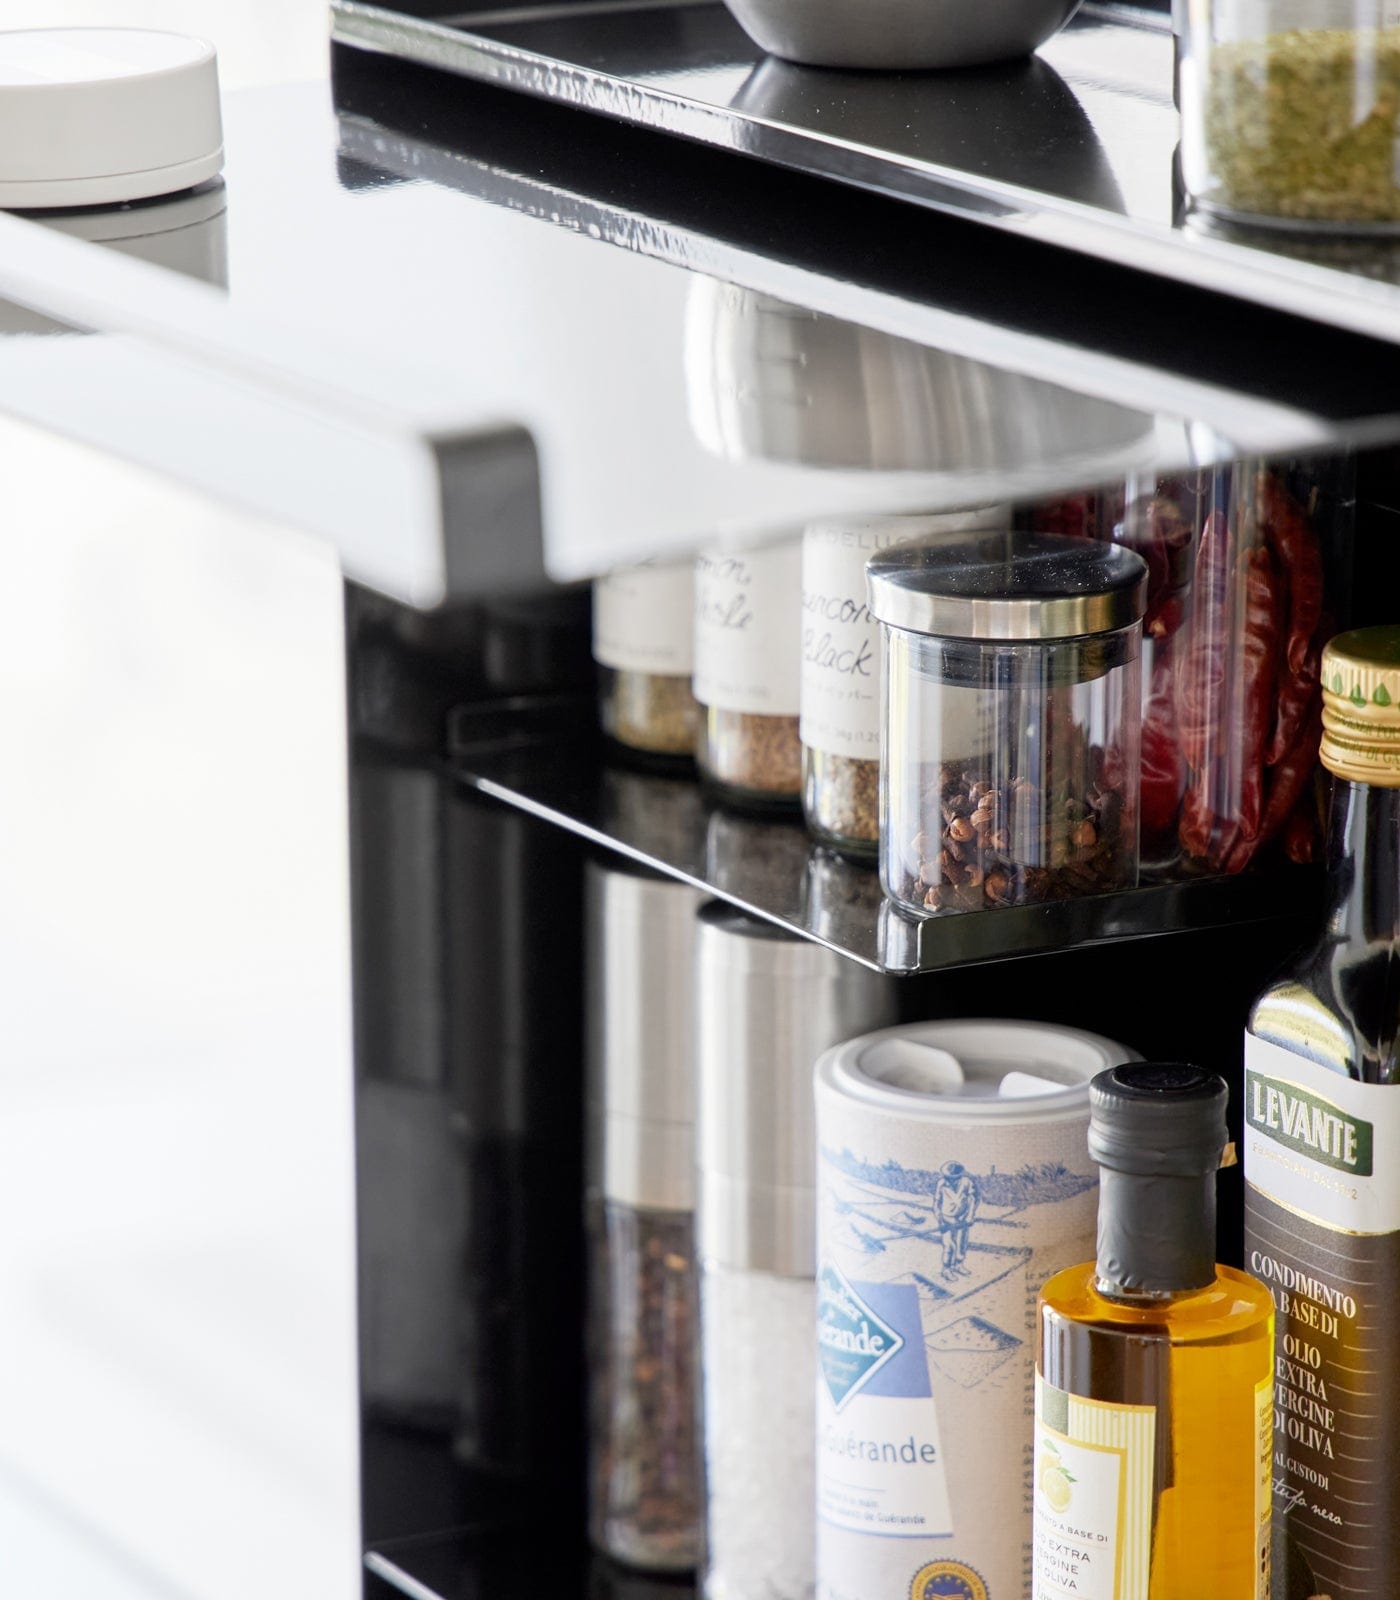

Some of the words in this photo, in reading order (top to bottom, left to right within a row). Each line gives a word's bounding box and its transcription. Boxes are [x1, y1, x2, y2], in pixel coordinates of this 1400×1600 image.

[1252, 1080, 1358, 1166] LEVANTE
[1251, 1250, 1356, 1319] CONDIMENTO
[1280, 1291, 1320, 1330] BASE
[1321, 1311, 1339, 1340] DI
[1283, 1334, 1321, 1370] OLIO
[1276, 1355, 1329, 1402] EXTRA
[1273, 1382, 1336, 1433] VERGINE
[1287, 1416, 1336, 1460] OLIVA
[1274, 1451, 1286, 1469] AL
[1318, 1472, 1329, 1491] DI
[1049, 1539, 1091, 1563] EXTRA
[1059, 1523, 1065, 1531] A
[1067, 1526, 1094, 1541] BASE
[1096, 1534, 1109, 1543] DI
[1043, 1567, 1078, 1591] OLIVA
